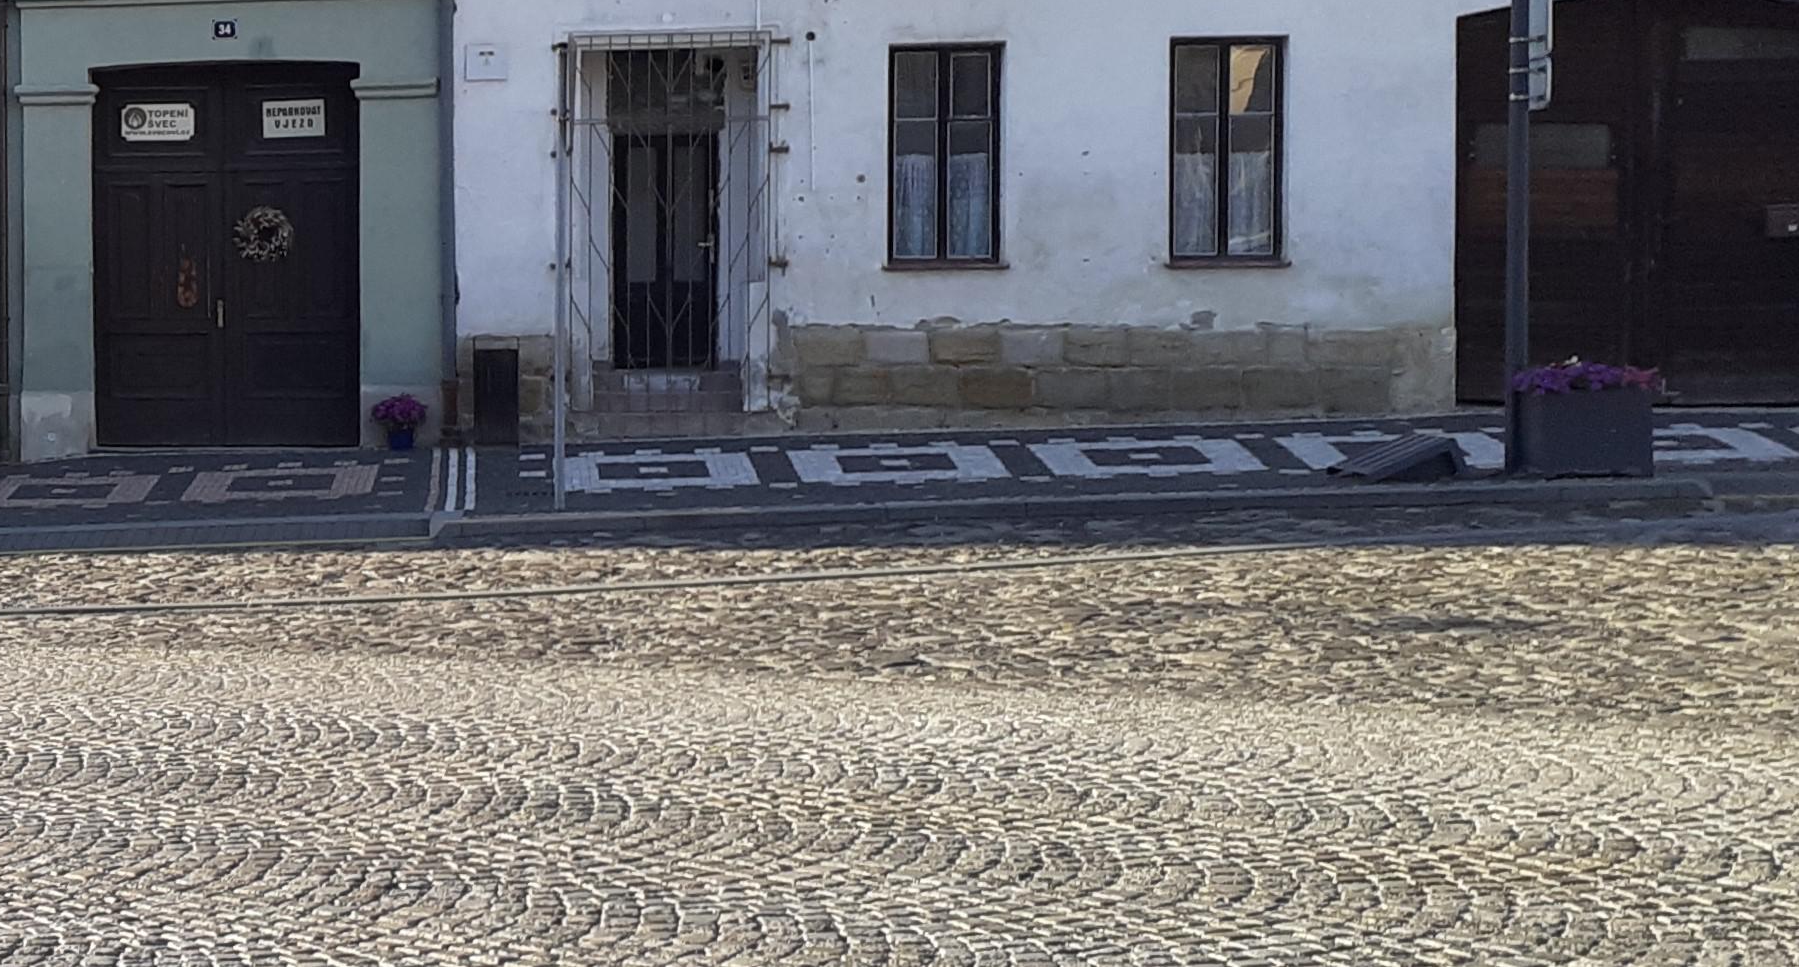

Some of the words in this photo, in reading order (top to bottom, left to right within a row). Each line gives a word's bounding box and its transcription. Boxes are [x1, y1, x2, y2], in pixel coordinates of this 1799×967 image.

[218, 23, 231, 35] 34
[265, 105, 321, 118] NEPARKOVAT
[274, 118, 314, 129] VJEZD
